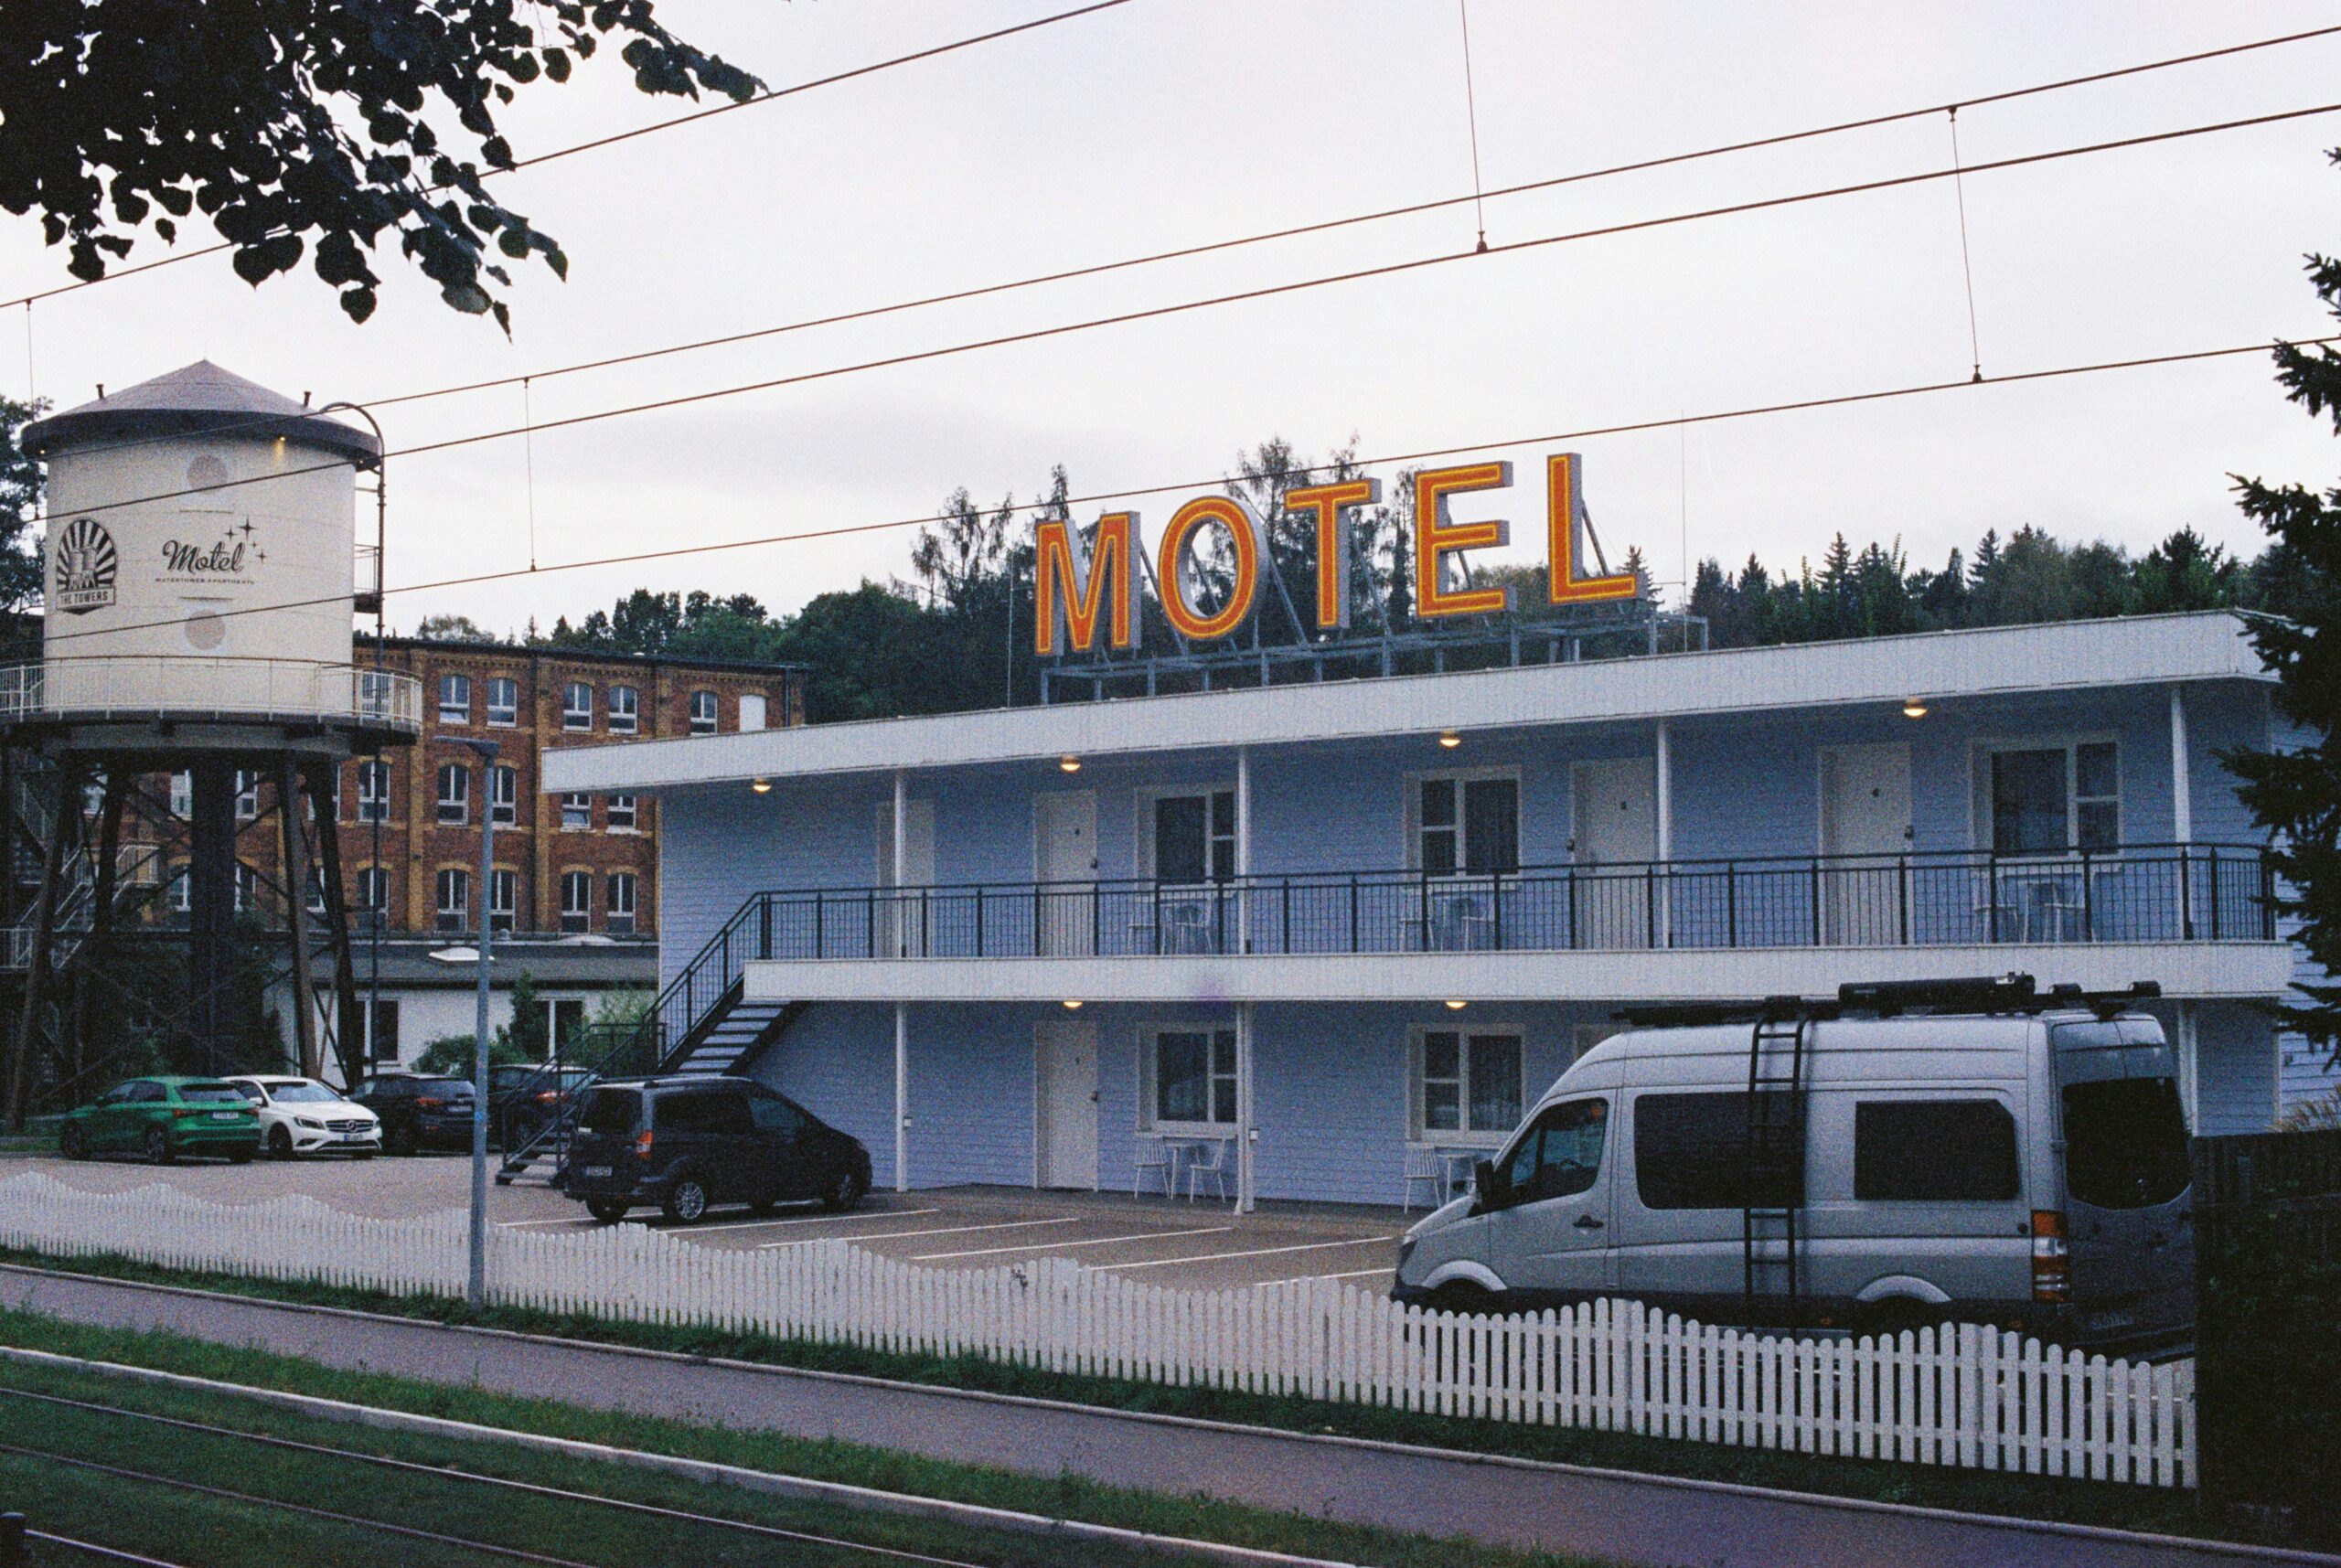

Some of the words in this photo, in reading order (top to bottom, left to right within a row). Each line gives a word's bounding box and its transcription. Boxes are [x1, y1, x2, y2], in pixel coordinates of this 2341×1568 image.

[162, 539, 246, 575] Motel
[1034, 452, 1648, 657] MOTEL
[60, 593, 72, 604] THE
[74, 590, 109, 604] TOWERS
